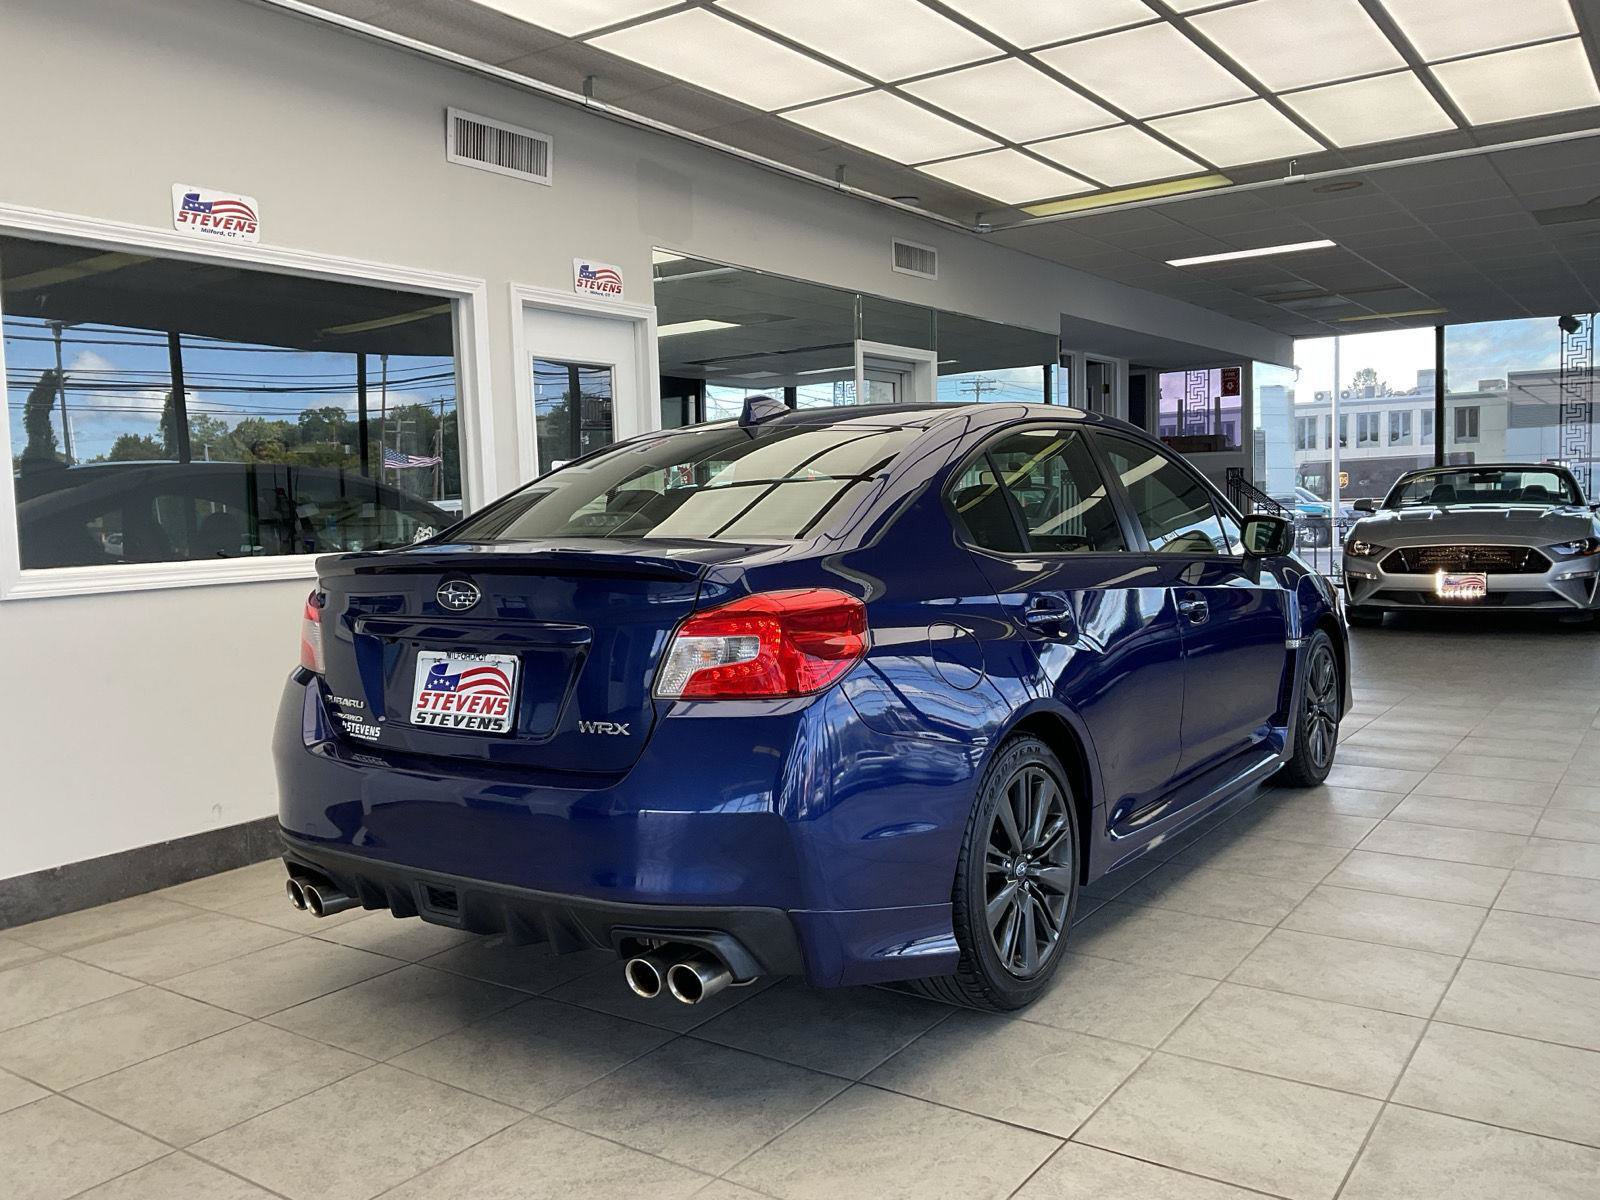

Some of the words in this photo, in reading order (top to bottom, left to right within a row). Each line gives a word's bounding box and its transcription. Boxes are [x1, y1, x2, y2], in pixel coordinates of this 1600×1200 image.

[177, 211, 257, 233] STEVENS
[201, 227, 226, 236] Milford,
[577, 279, 622, 294] STEVENS
[325, 694, 364, 708] SUBARU
[417, 692, 510, 715] STEVENS
[347, 721, 381, 737] STEVENS
[415, 712, 505, 731] STEVENS
[578, 720, 630, 736] WRX
